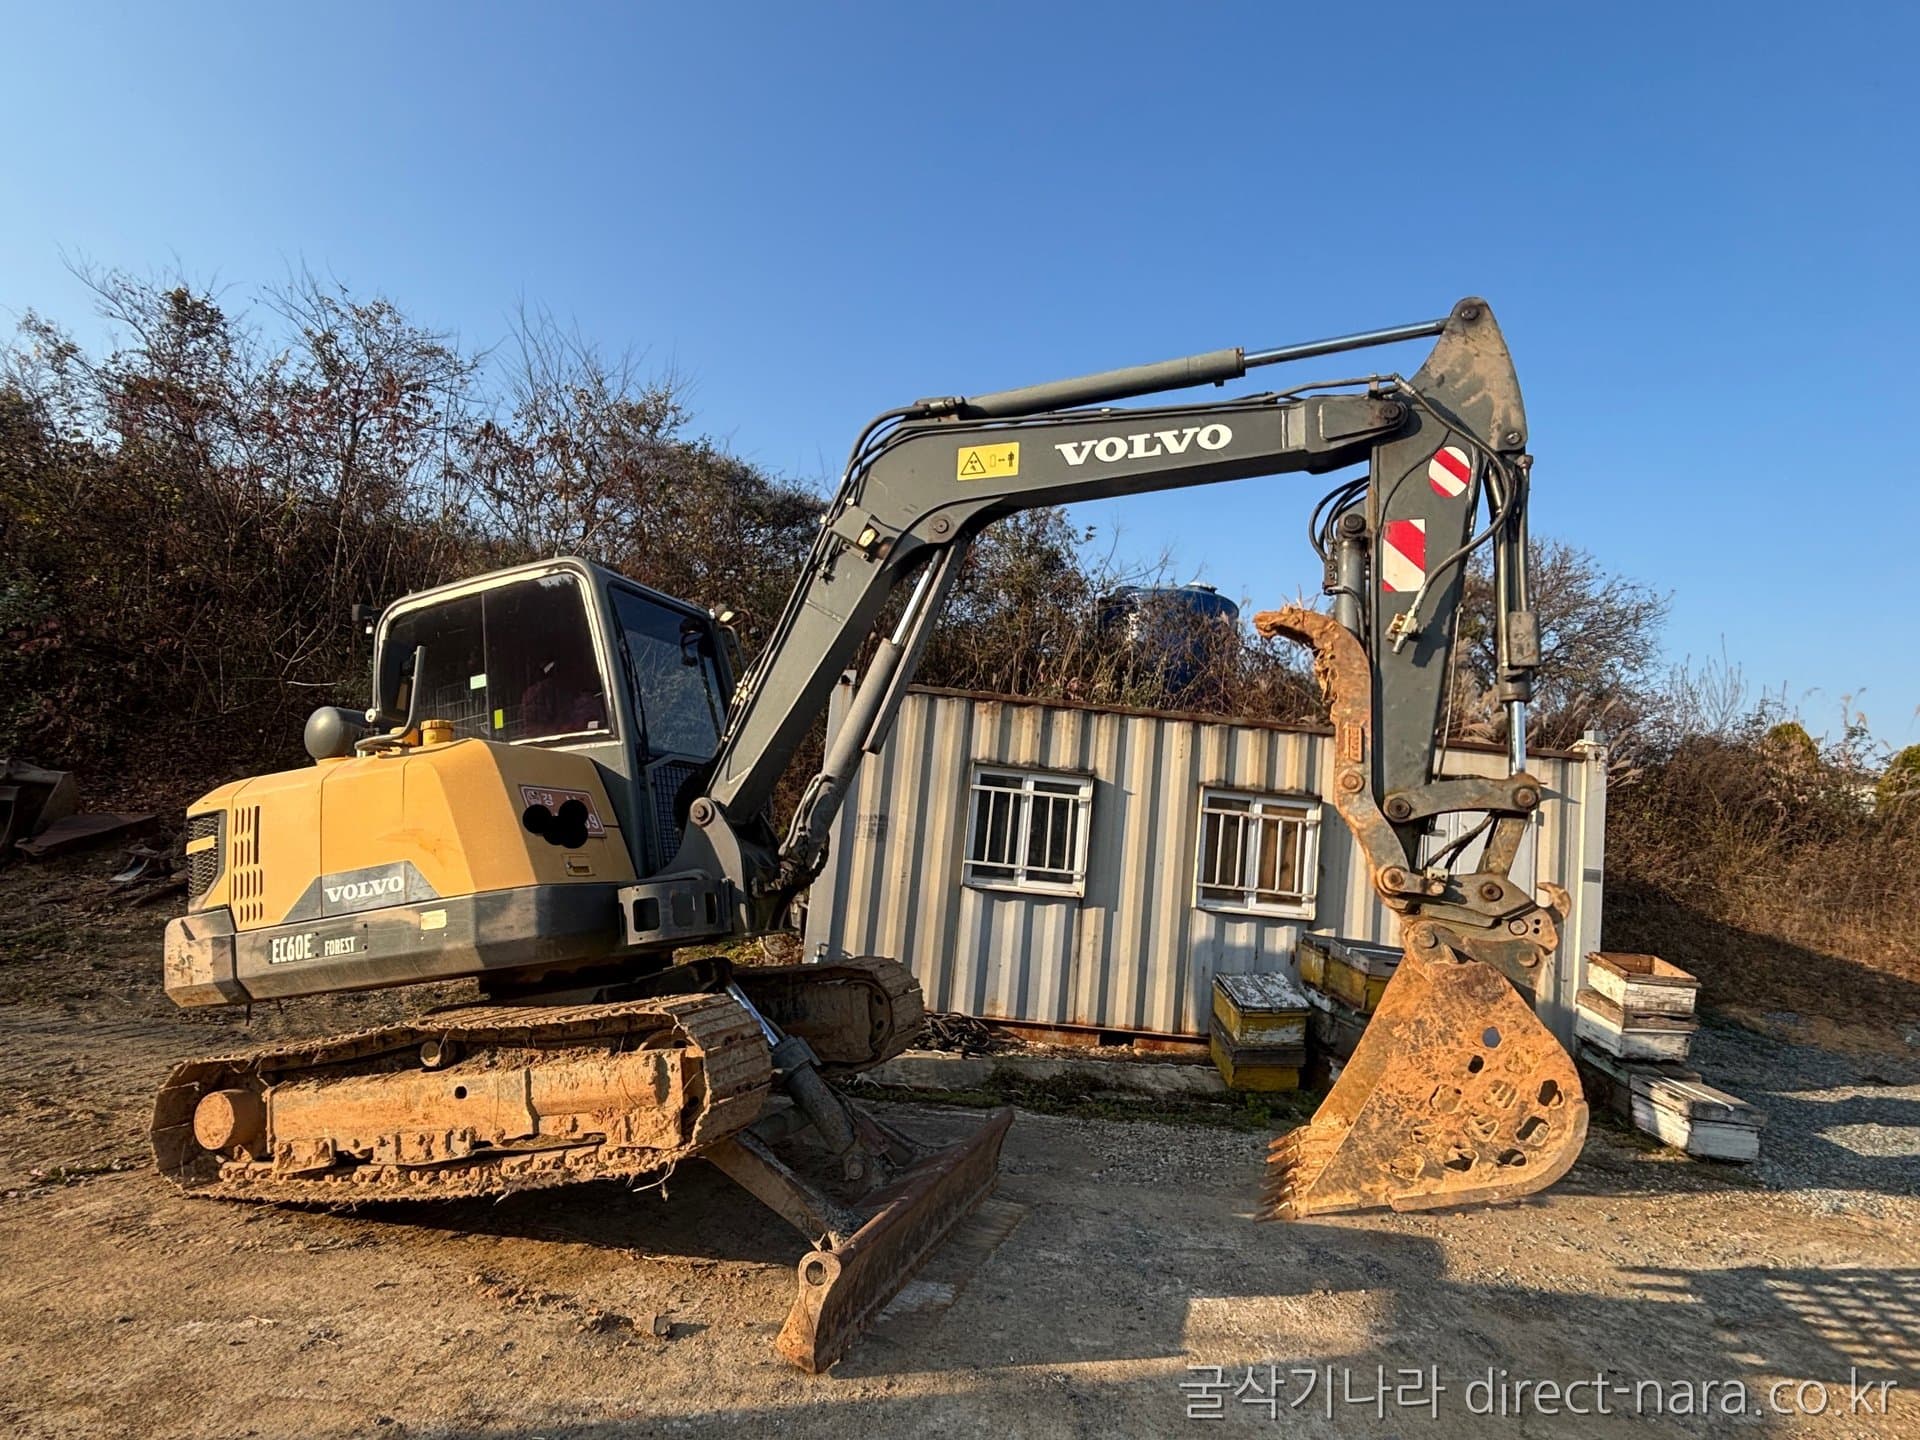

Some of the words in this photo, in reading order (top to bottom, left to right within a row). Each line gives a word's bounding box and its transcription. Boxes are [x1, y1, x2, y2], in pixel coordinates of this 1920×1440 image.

[1055, 423, 1233, 466] VOLVO
[324, 876, 405, 903] VOLVO
[272, 933, 313, 964] EC60E
[324, 936, 358, 957] FOREST
